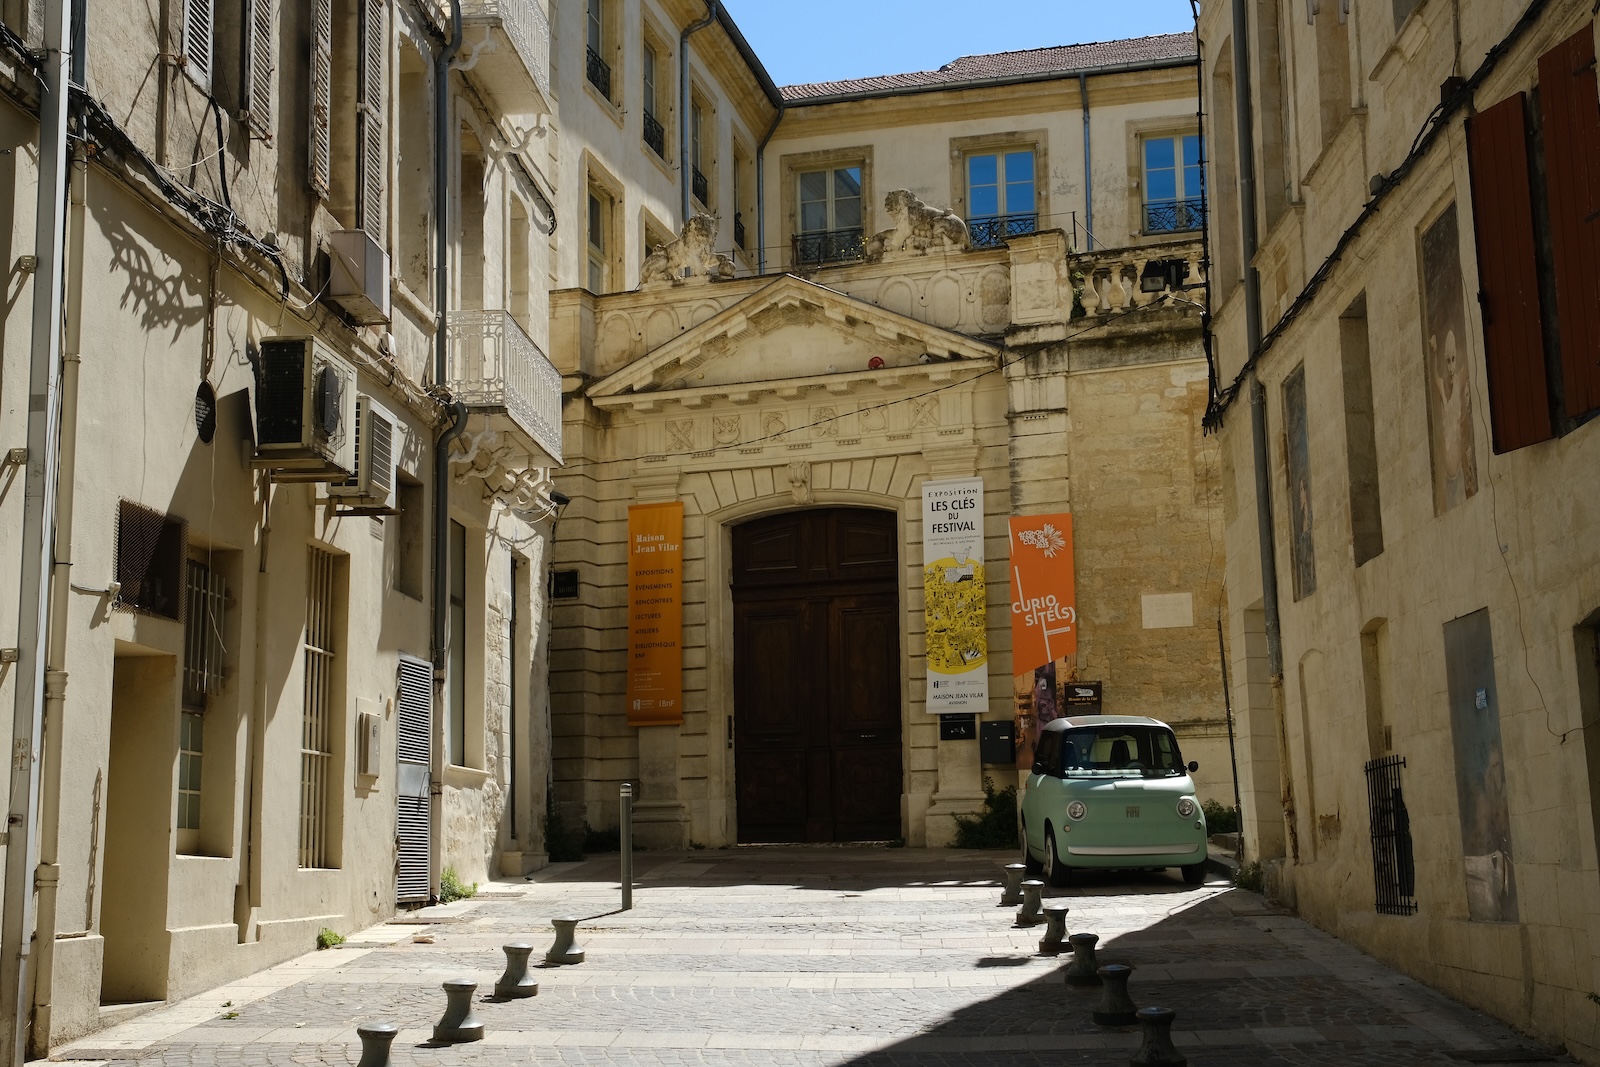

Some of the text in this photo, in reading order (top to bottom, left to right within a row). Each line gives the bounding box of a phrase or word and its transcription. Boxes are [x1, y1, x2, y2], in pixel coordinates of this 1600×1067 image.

[931, 496, 975, 512] LES CLÉS
[932, 521, 976, 534] FESTIVAL
[636, 534, 665, 542] Maison
[636, 544, 679, 553] Jean Vilar
[636, 568, 674, 576] EXPOSITIONS
